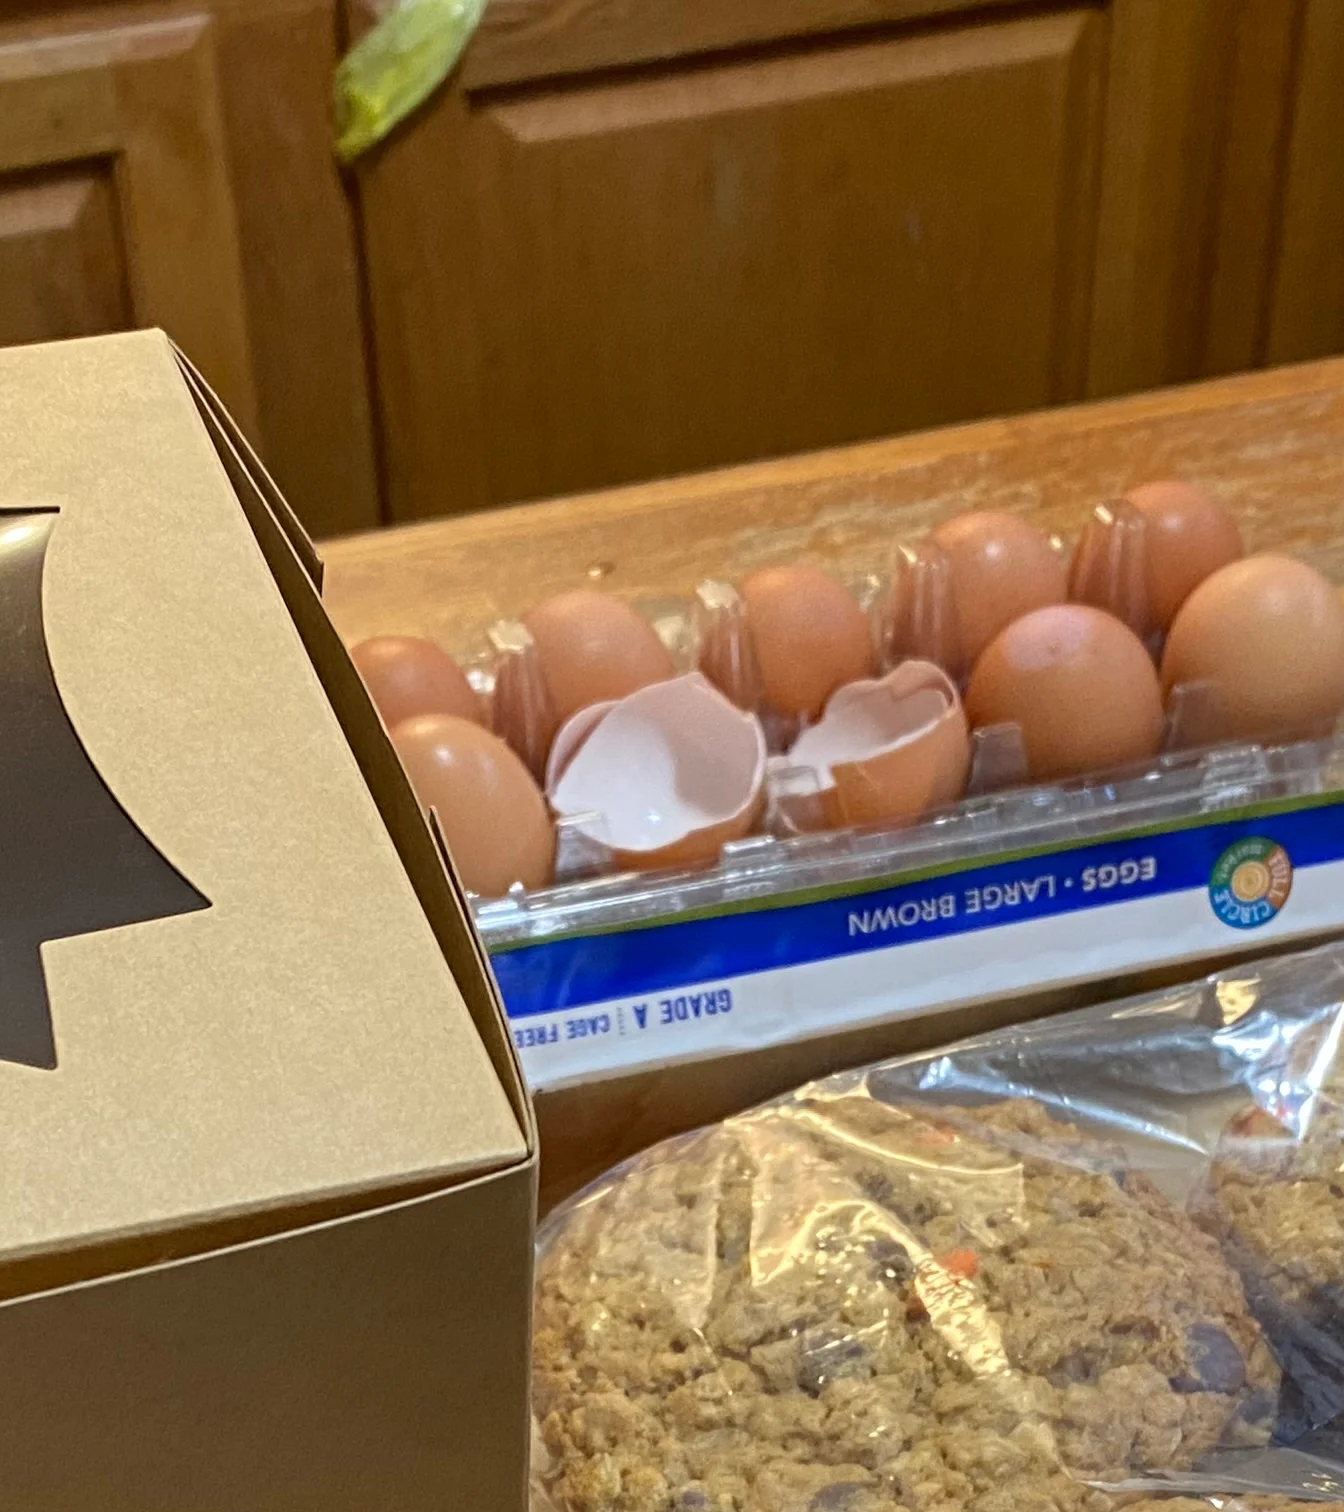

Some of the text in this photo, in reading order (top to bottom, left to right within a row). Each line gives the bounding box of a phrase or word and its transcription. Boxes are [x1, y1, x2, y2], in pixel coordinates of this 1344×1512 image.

[1267, 848, 1289, 899] FULL
[847, 856, 1157, 937] EGGS LARGE BROWN
[1213, 888, 1271, 925] CIRCLE
[632, 988, 733, 1029] GRADE A
[513, 1013, 610, 1049] CAGE FREE
